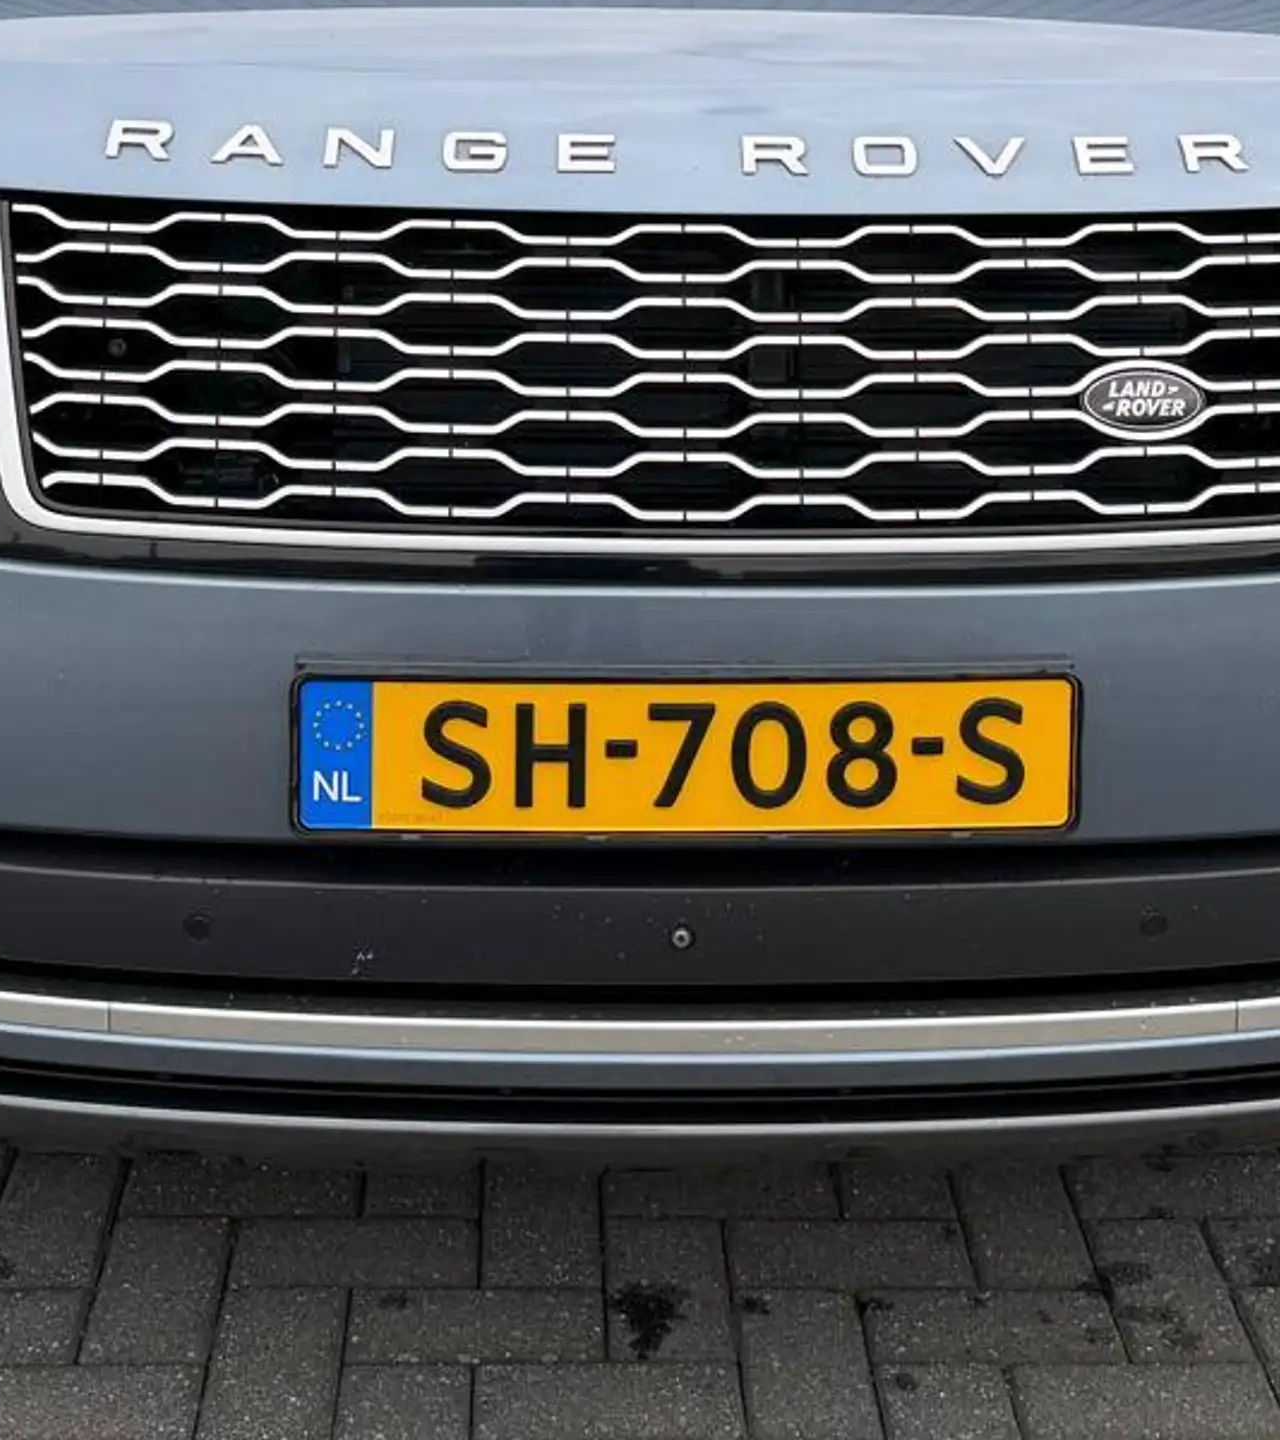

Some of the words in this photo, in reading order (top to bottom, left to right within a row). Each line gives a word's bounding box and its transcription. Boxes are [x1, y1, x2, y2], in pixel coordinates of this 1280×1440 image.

[105, 120, 616, 174] RANGE
[741, 134, 1249, 177] ROVER
[1108, 380, 1167, 398] LAND
[1115, 398, 1186, 417] ROVER
[422, 697, 1025, 810] SH-708-S
[312, 770, 362, 803] NL
